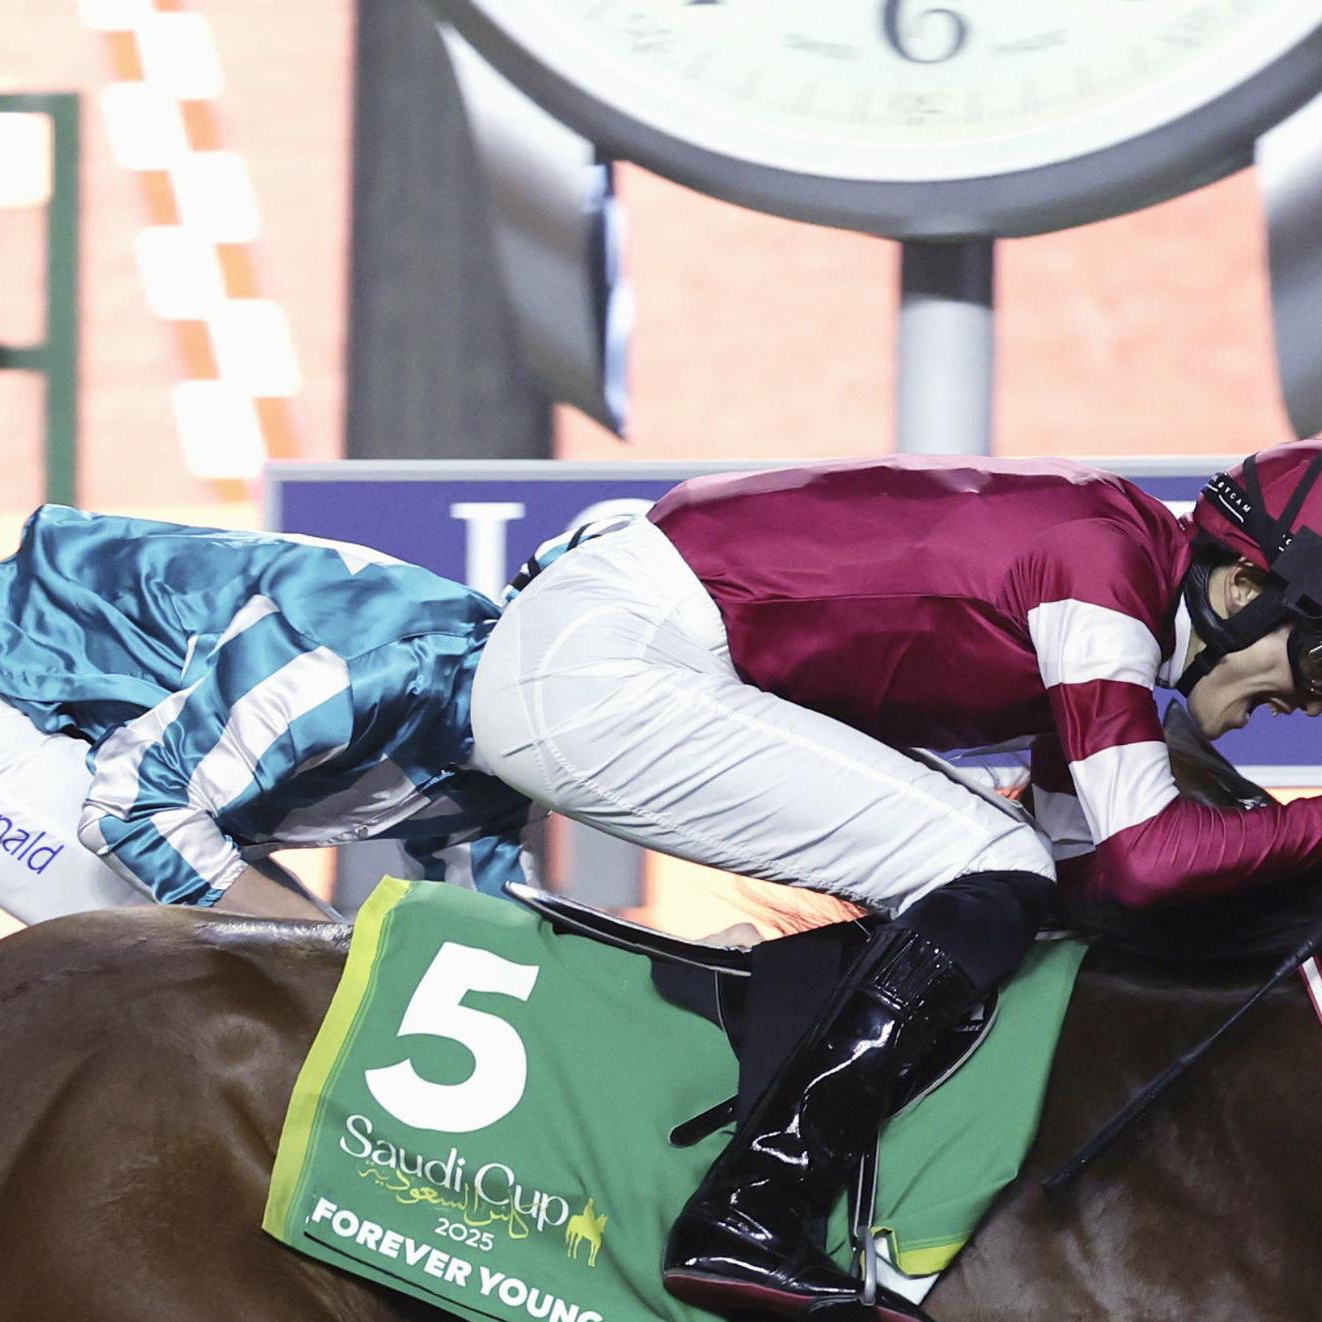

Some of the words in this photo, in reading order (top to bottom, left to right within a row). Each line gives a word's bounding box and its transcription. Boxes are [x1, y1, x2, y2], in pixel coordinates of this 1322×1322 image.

[879, 0, 969, 64] 6
[365, 941, 540, 1133] 5
[339, 1114, 466, 1192] Saudi
[474, 1163, 569, 1231] Cup
[311, 1197, 473, 1287] FOREVER
[435, 1218, 495, 1251] 2025
